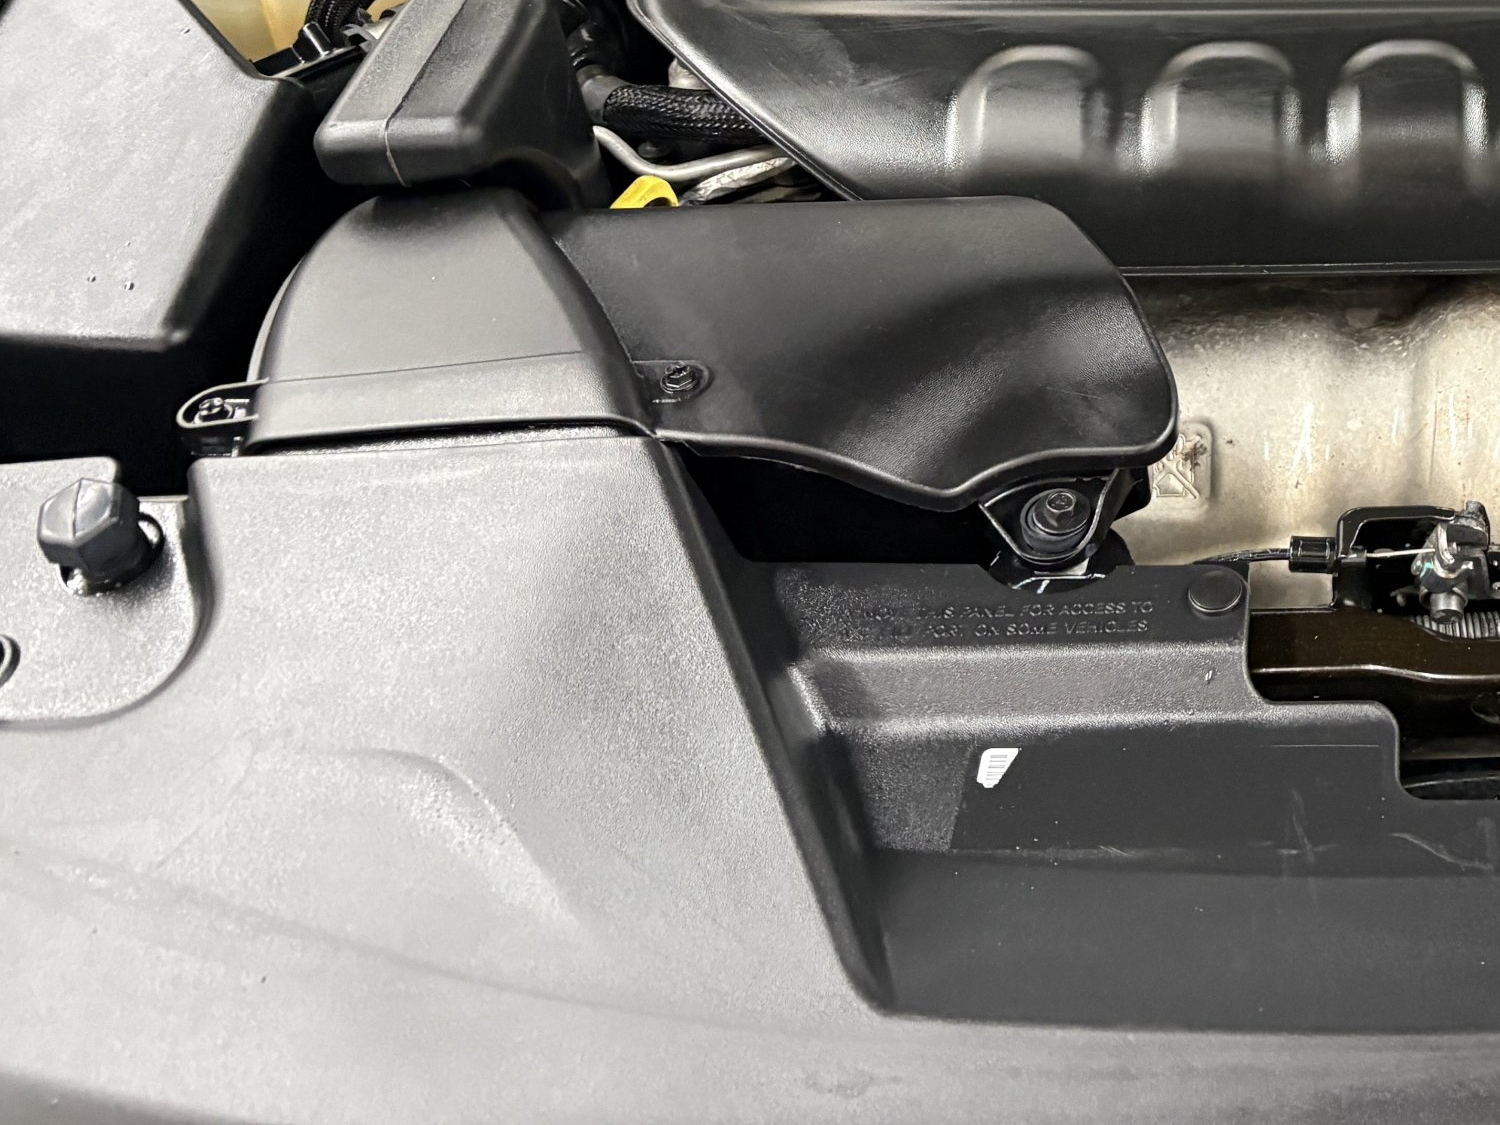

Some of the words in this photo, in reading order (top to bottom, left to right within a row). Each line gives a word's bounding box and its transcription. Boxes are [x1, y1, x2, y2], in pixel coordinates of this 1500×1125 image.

[960, 604, 1015, 618] PANEL
[1020, 603, 1055, 617] FOR
[1059, 602, 1126, 615] ACCESS
[1131, 600, 1153, 614] TO
[975, 623, 1000, 637] ON
[1006, 622, 1057, 636] SOME
[1064, 619, 1148, 634] VEHICLES
